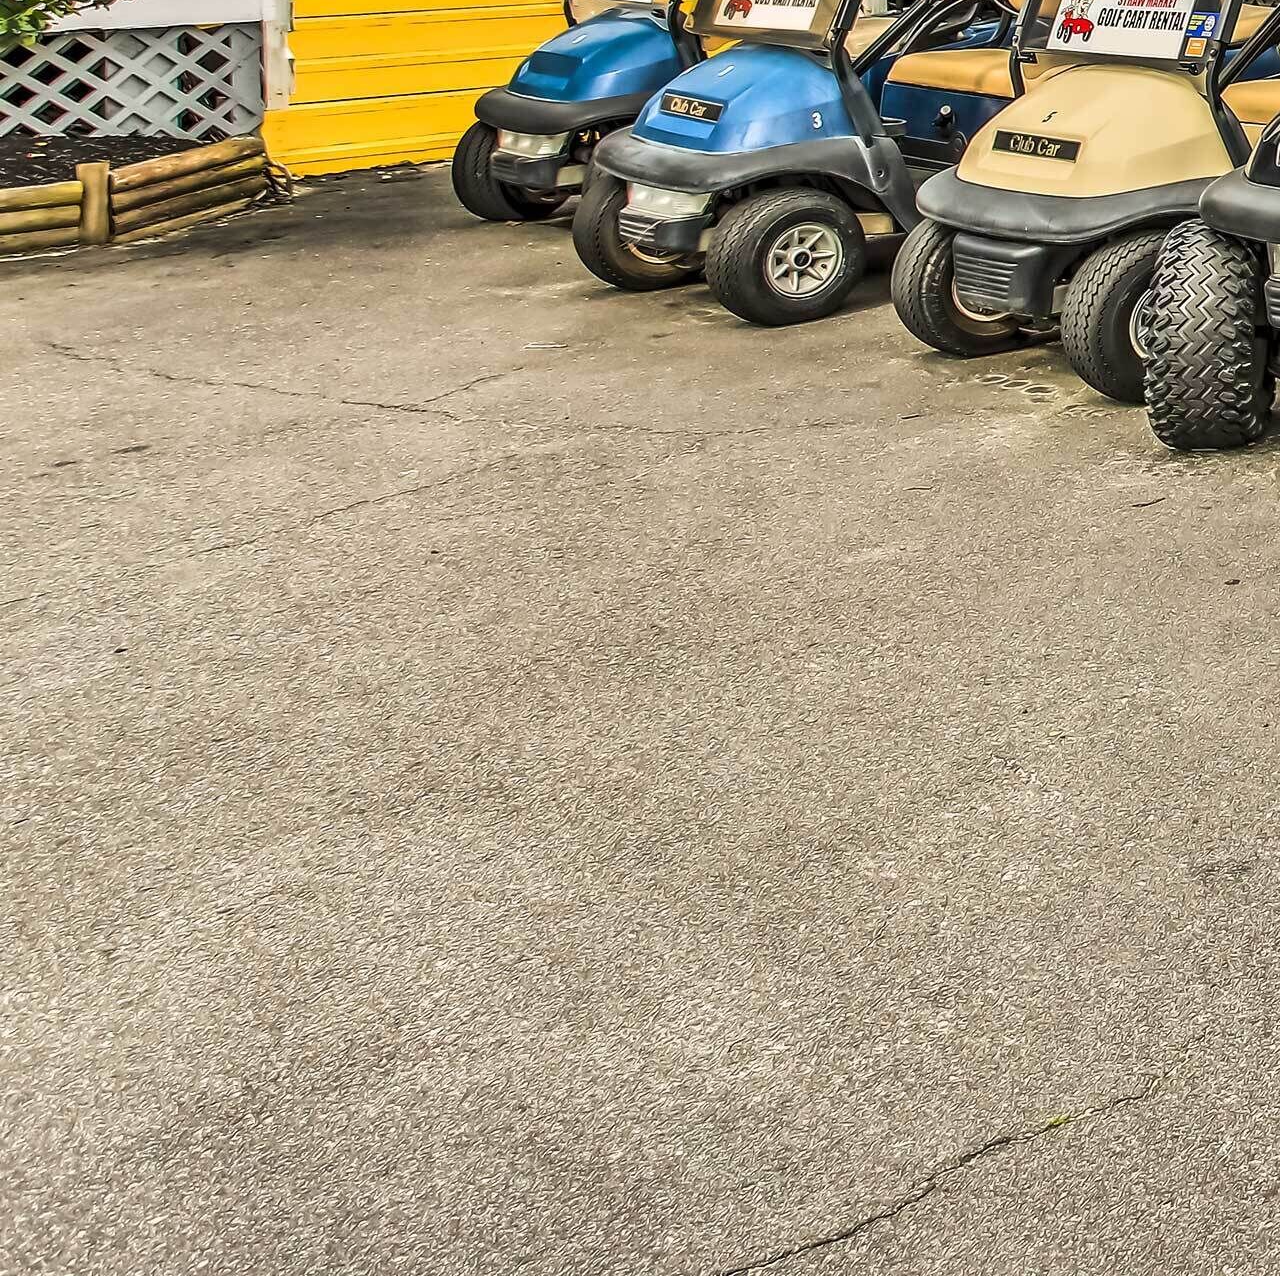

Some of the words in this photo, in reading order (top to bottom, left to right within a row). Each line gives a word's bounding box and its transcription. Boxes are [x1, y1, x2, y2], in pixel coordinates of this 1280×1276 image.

[1098, 8, 1124, 28] GOLF
[1123, 10, 1151, 29] CART
[1150, 11, 1187, 31] RENTAL
[670, 98, 687, 113] Club
[689, 102, 707, 117] Car
[1041, 111, 1058, 123] 5
[811, 111, 823, 129] 3
[1010, 135, 1035, 152] Club
[1037, 139, 1061, 156] Car
